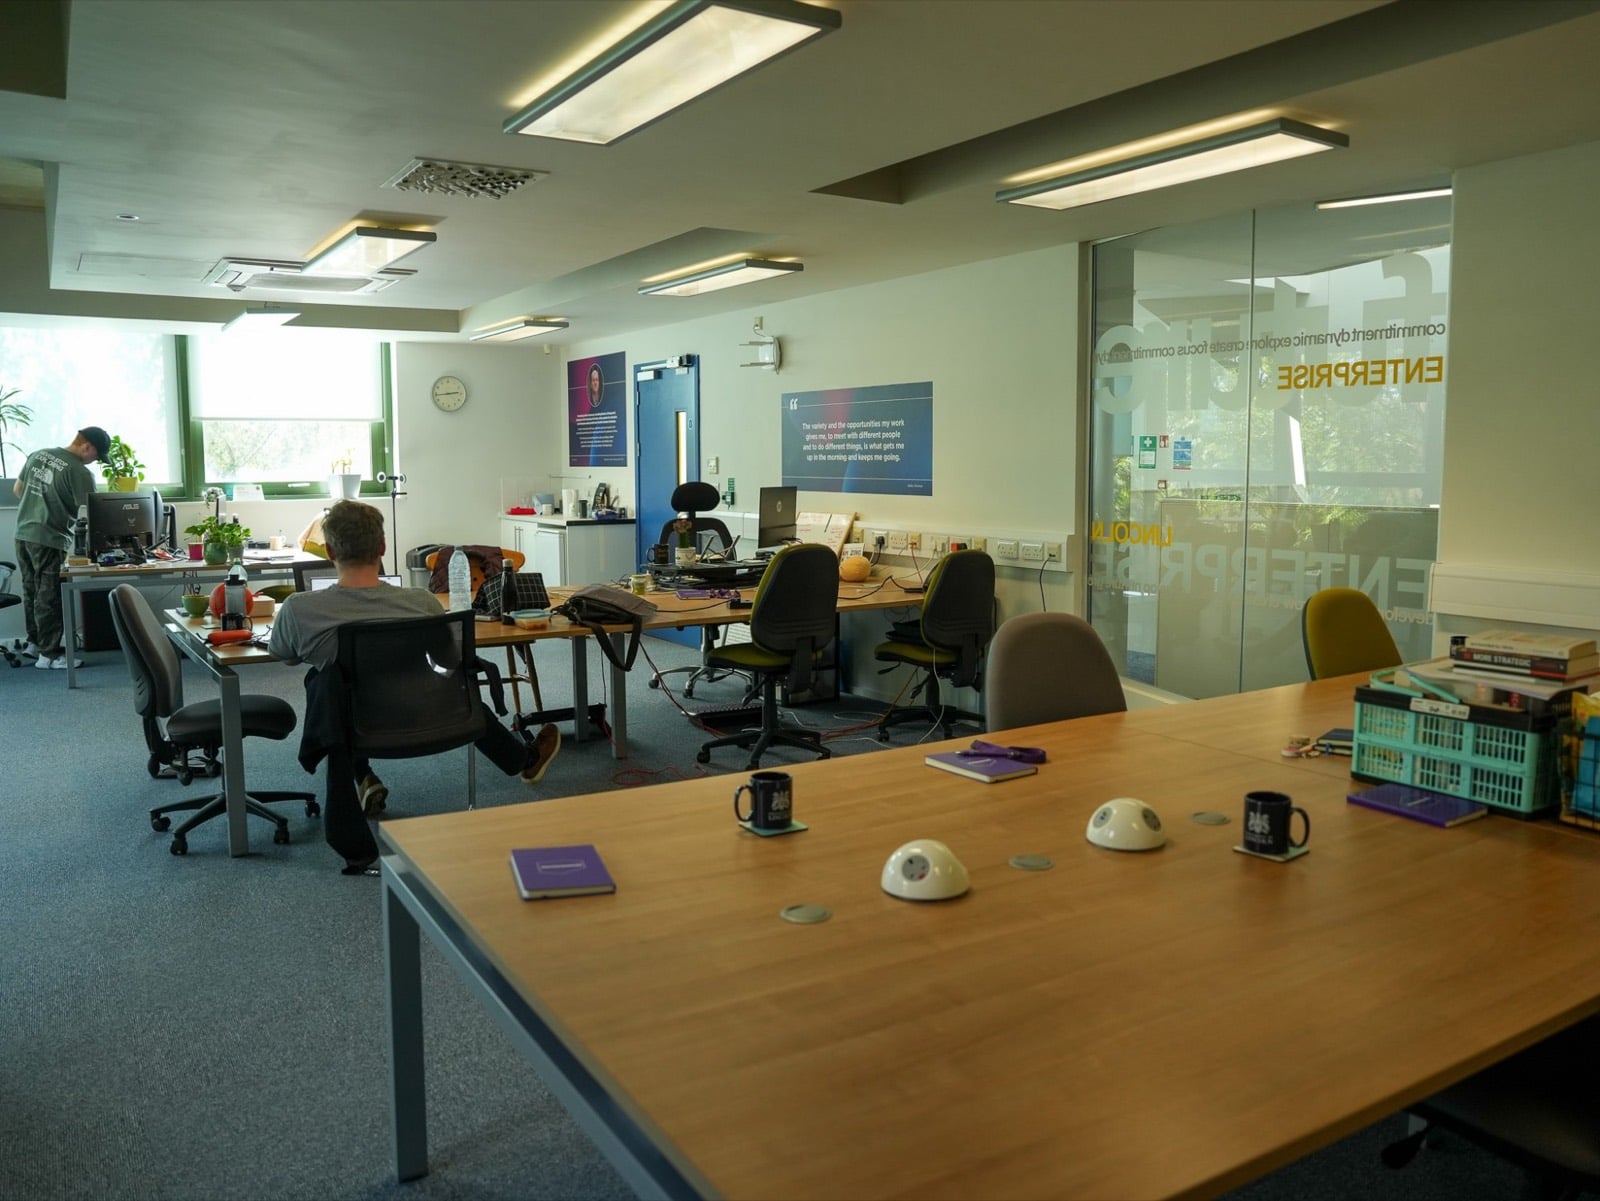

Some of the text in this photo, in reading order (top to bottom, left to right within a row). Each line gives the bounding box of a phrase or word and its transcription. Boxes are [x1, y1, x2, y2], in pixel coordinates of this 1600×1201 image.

[811, 422, 828, 430] variety
[828, 421, 837, 429] and
[838, 421, 846, 429] the
[846, 420, 881, 429] opportunities
[881, 421, 890, 429] my
[890, 418, 905, 426] work
[806, 433, 818, 441] gives
[859, 431, 881, 439] different
[881, 430, 901, 439] people
[825, 442, 846, 450] different
[863, 442, 868, 450] is
[869, 442, 882, 450] what
[882, 442, 895, 451] gets
[827, 454, 848, 462] morning
[858, 453, 874, 462] keeps
[883, 453, 901, 462] going.
[1472, 652, 1492, 663] MORE
[1493, 654, 1532, 667] STRATEGIC
